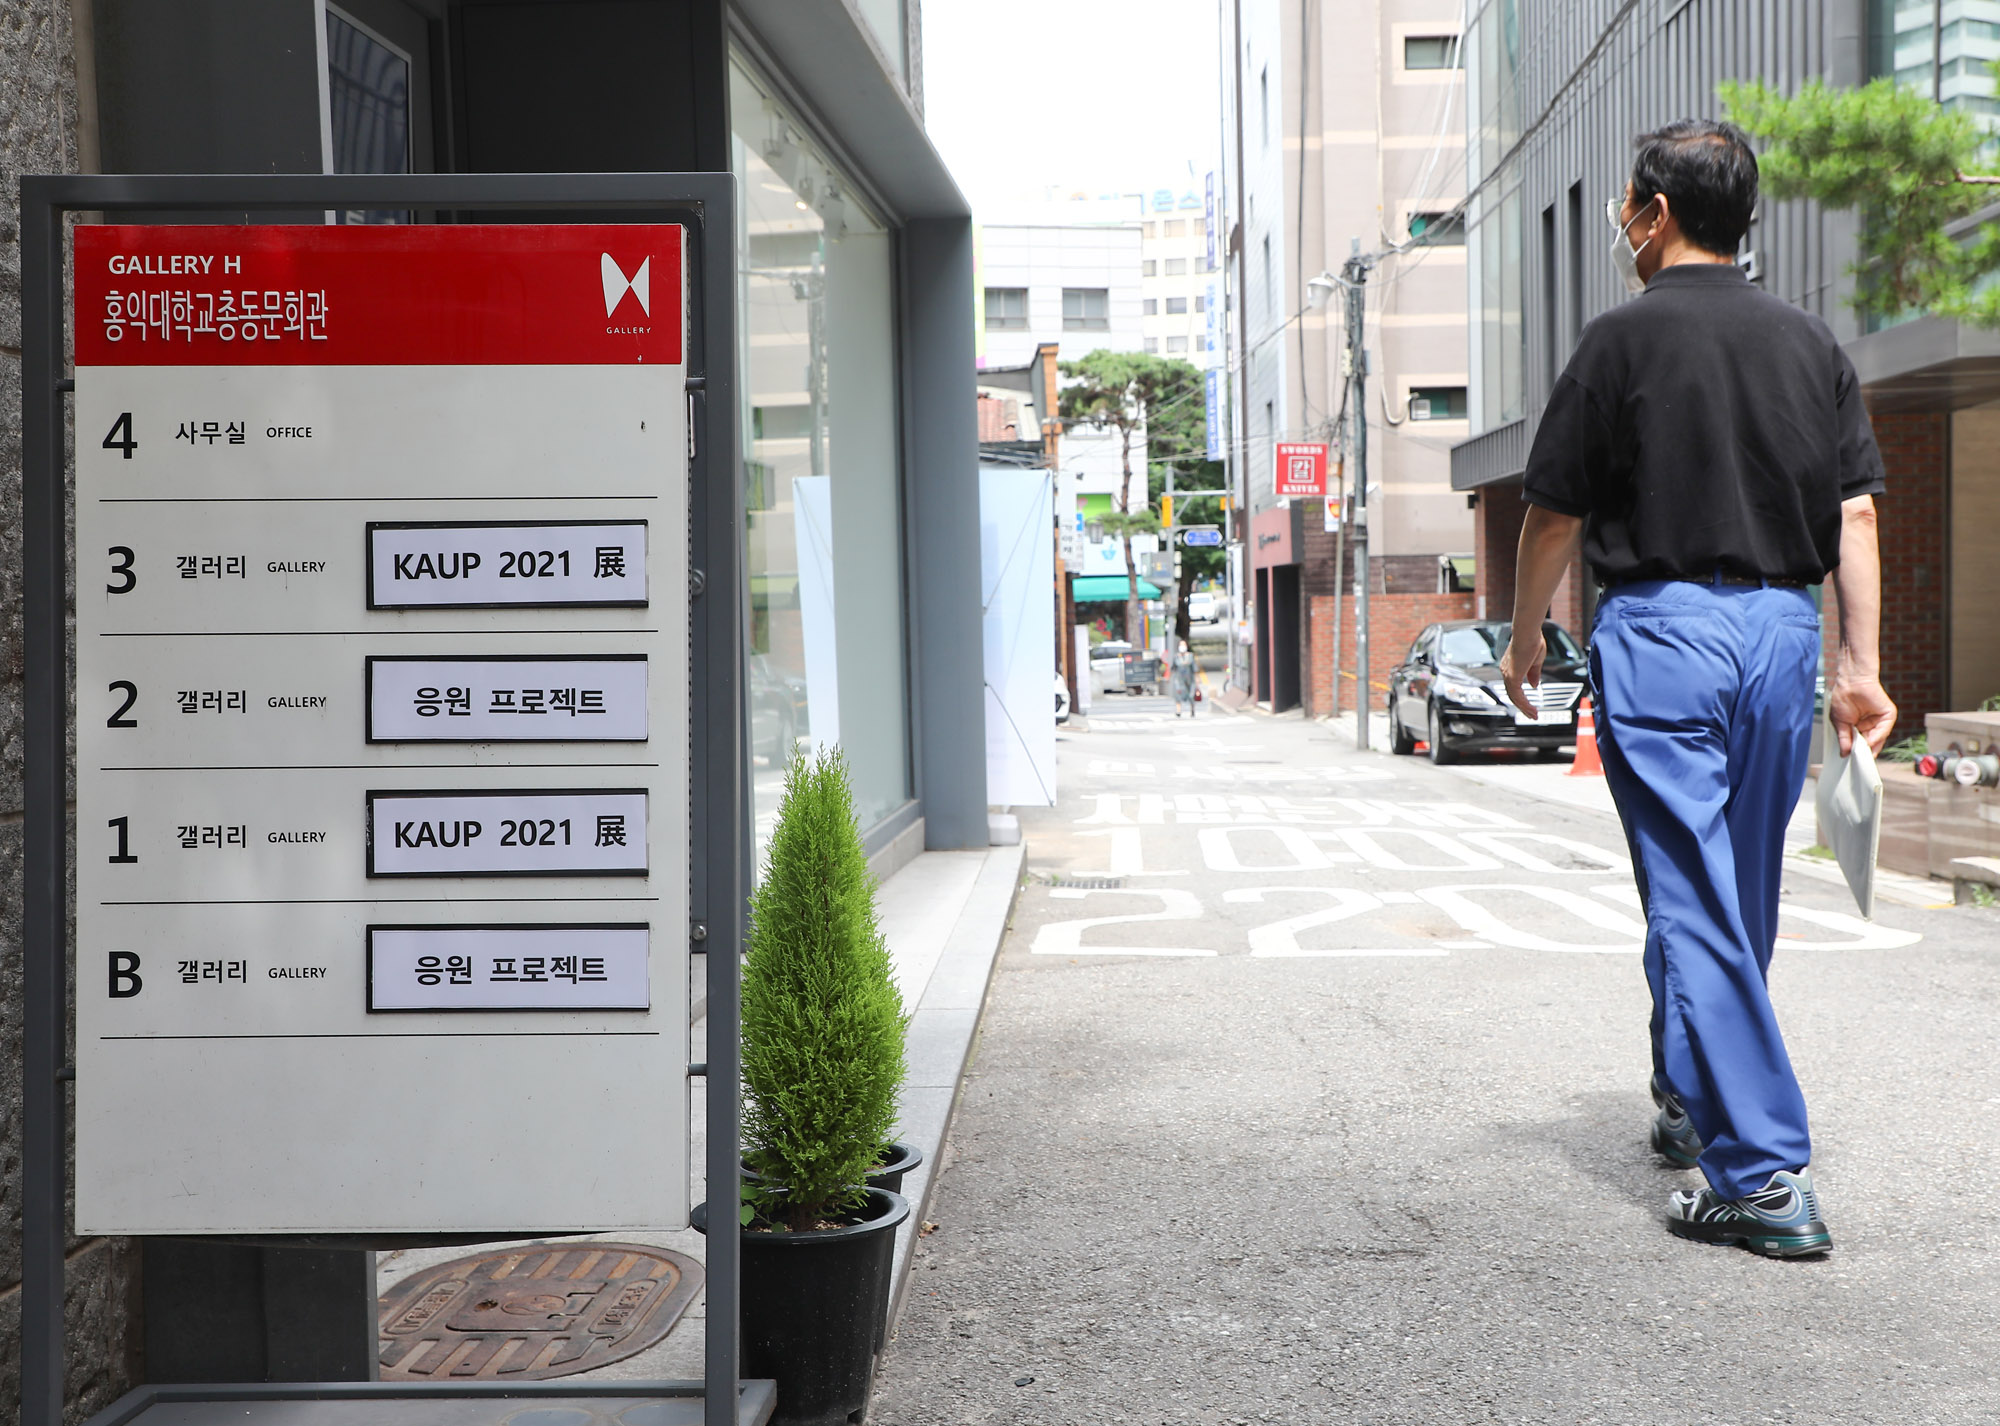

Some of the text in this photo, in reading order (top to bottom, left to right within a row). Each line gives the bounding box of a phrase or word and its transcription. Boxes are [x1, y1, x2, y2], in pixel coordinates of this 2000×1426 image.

[109, 256, 240, 274] GALLERY H
[104, 290, 328, 342] 홍익대학교총동문회관
[103, 412, 312, 459] 4 사무실 OFFICE
[107, 546, 325, 594] 3 갤러리 GALLERY
[394, 547, 625, 580] KAUP 2021 展
[107, 680, 326, 728] 2 갤러리 GALLERY
[414, 687, 606, 716] 응원 프로젝트
[108, 816, 326, 863] 1 갤러리 GALLERY
[395, 816, 626, 848] KAUP 2021 展
[109, 951, 326, 998] B 갤러리 GALLERY
[415, 956, 607, 985] 응원 프로젝트
